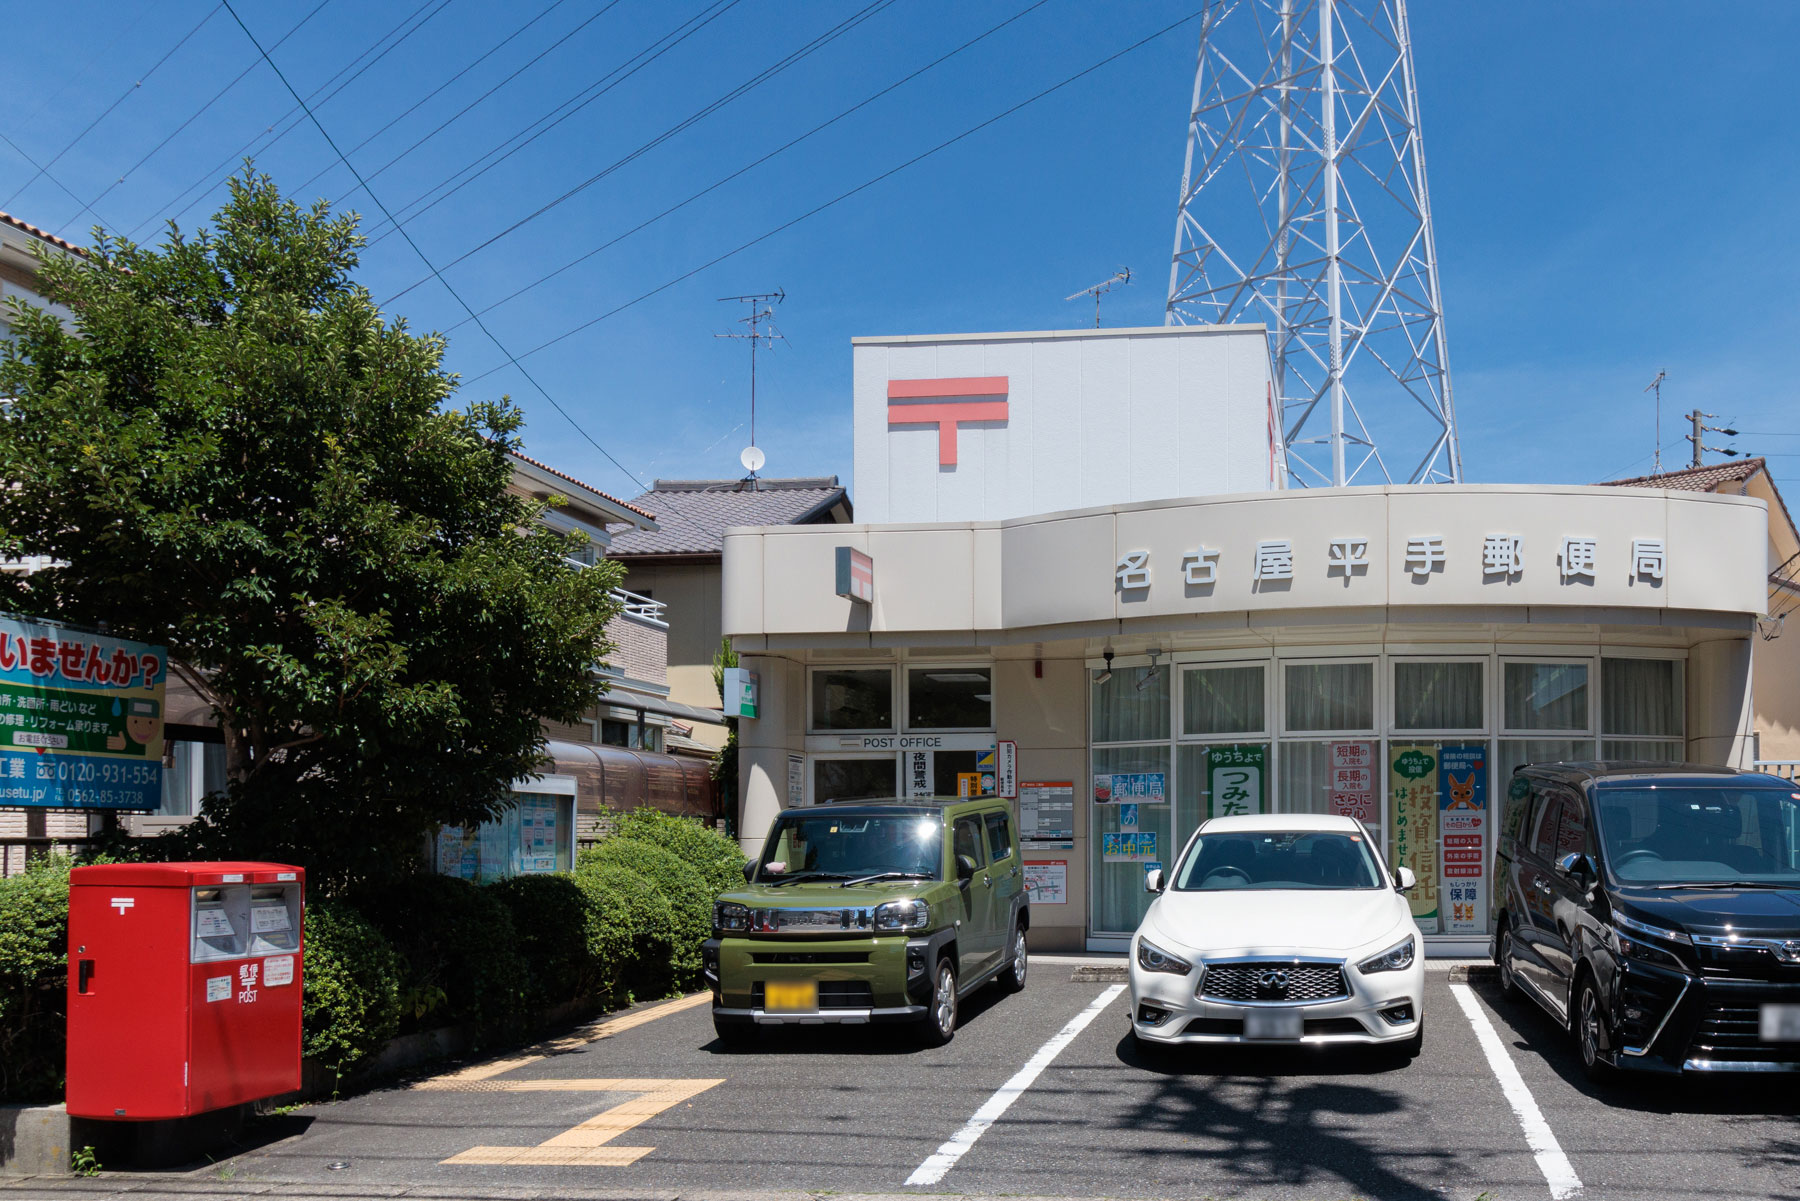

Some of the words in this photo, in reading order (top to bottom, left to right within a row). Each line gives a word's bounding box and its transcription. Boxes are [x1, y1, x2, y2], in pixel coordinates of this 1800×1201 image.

[1117, 534, 1666, 589] 名古屋平手郵便局
[0, 632, 160, 688] いませんか?
[0, 695, 97, 716] 所・洗面所・雨どいなど
[864, 738, 895, 748] POST
[900, 737, 942, 748] OFFICE
[1211, 752, 1262, 763] ゆうちょで
[1336, 745, 1368, 758] 短期の
[1402, 757, 1429, 765] ゆうちょで
[58, 761, 157, 785] 0120-931-554
[913, 752, 927, 788] 夜間警戒
[1337, 770, 1368, 782] 長期の
[67, 789, 144, 804] 0562-85-3738
[1114, 781, 1162, 798] 郵便局
[1222, 772, 1250, 816] つみた
[1334, 793, 1372, 807] さらに
[1124, 815, 1136, 825] の
[1339, 806, 1366, 820] 安心
[1105, 841, 1155, 857] お中元
[1449, 889, 1478, 901] 保障
[239, 964, 259, 979] 郵便
[238, 990, 258, 1004] POST
